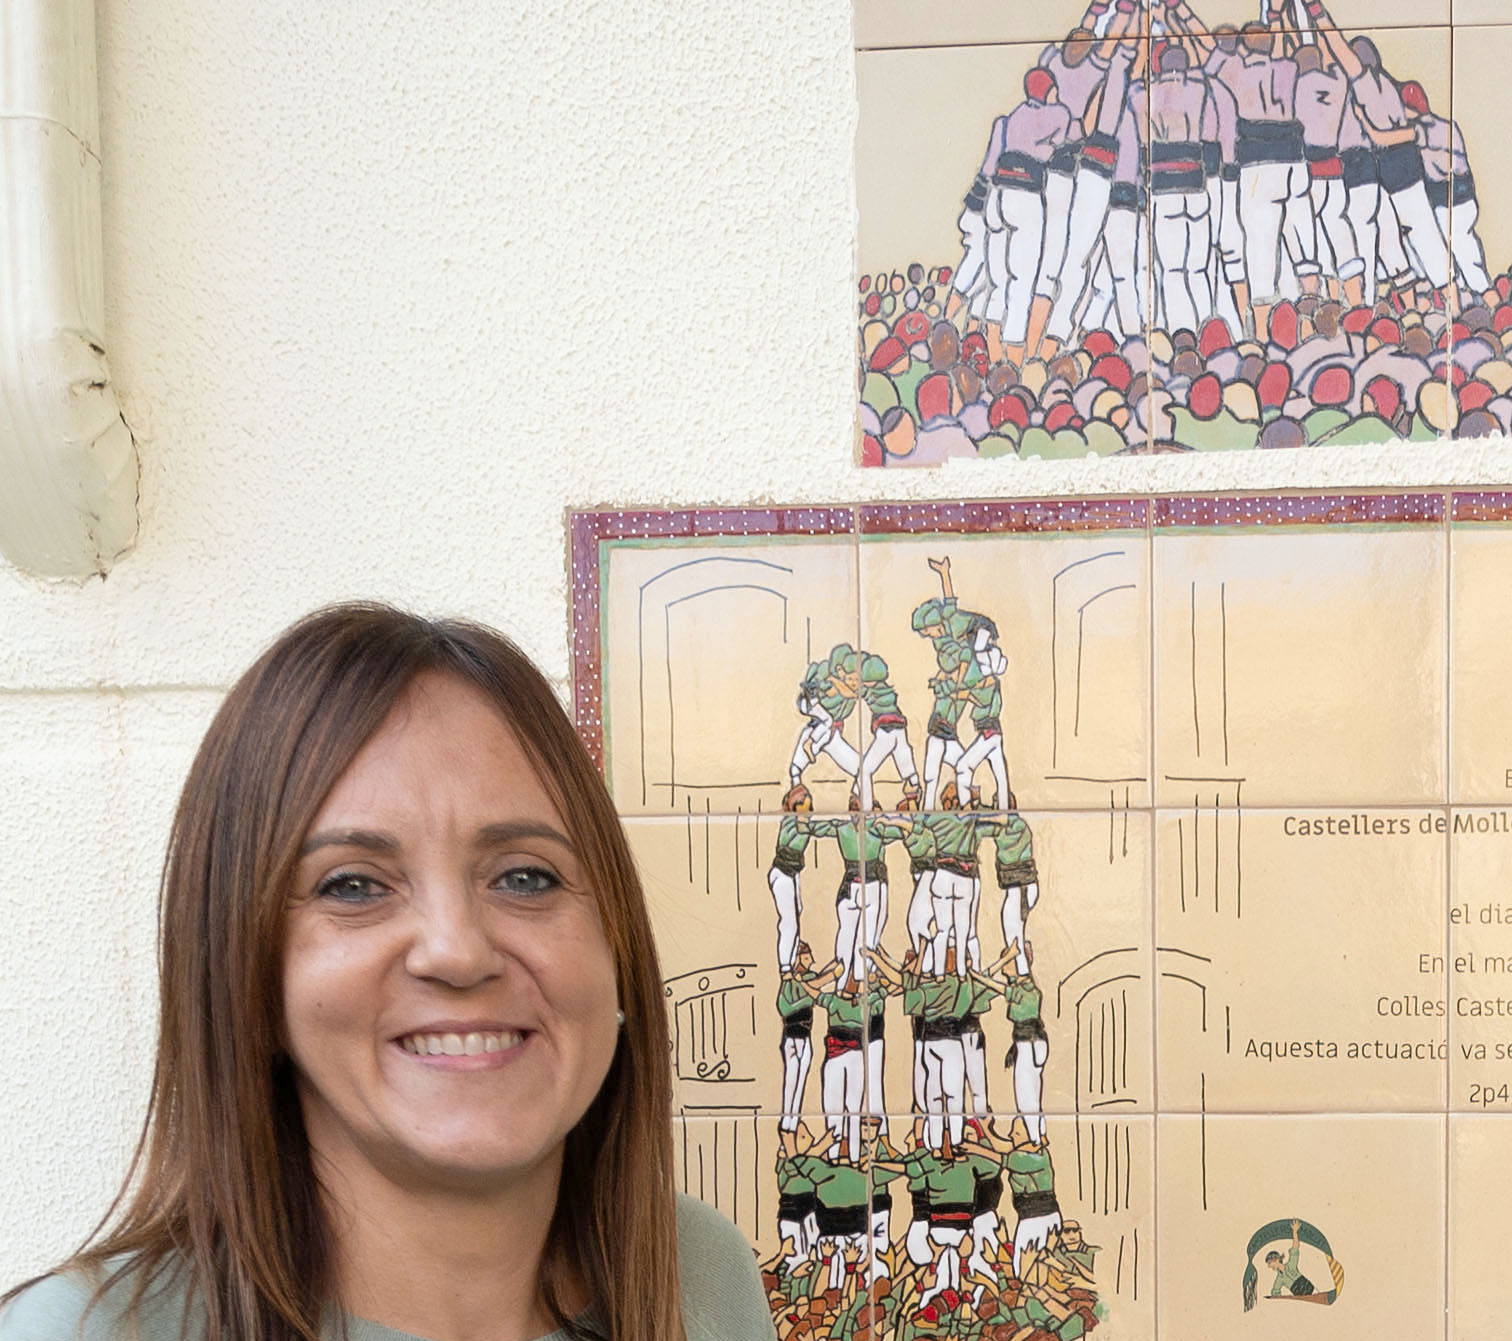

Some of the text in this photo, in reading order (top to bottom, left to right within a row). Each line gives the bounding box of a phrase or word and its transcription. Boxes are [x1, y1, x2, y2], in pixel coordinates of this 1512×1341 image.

[1283, 814, 1411, 836] Castellers
[1418, 812, 1448, 835] de
[1450, 903, 1472, 924] el
[1418, 953, 1444, 974] En
[1454, 952, 1476, 973] el
[1376, 994, 1446, 1017] Colles
[1244, 1038, 1339, 1062] Aquesta
[1347, 1039, 1448, 1060] actuació
[1460, 1043, 1486, 1060] va
